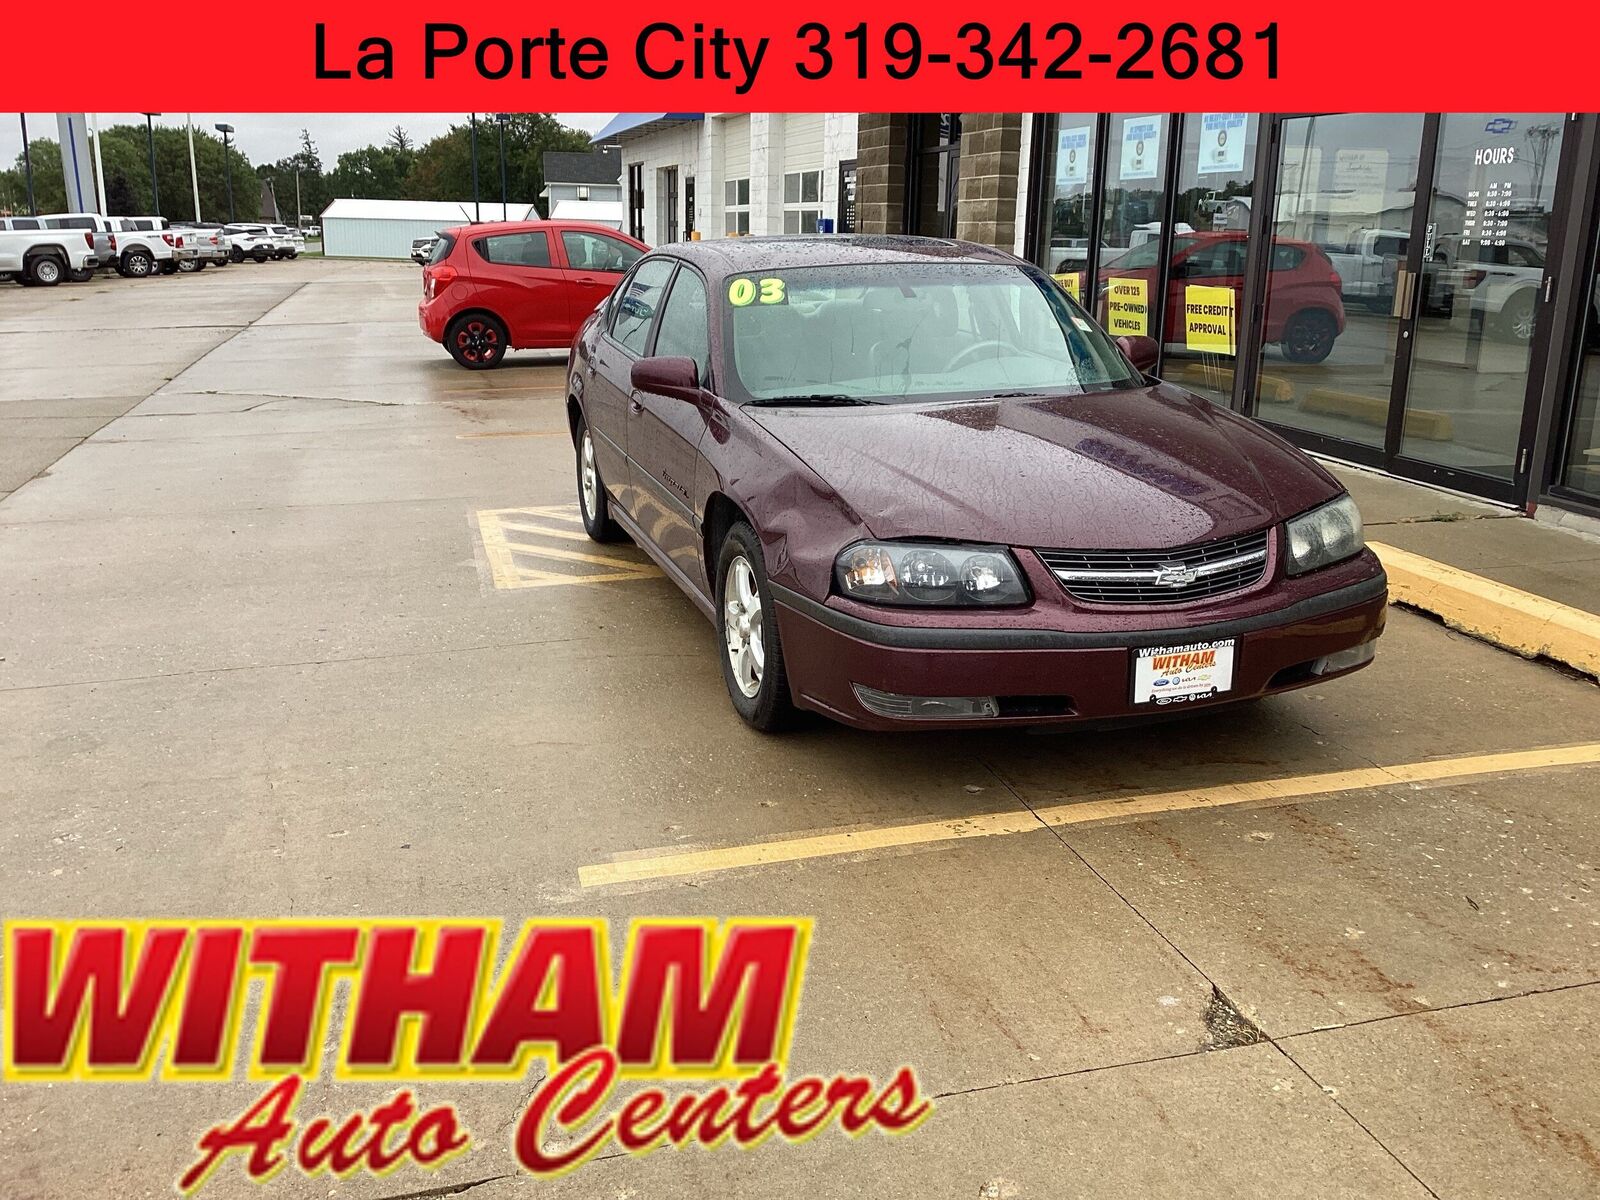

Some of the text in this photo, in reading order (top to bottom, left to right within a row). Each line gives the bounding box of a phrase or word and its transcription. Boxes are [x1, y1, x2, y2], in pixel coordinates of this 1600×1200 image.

[1475, 147, 1515, 165] HOURS
[1425, 224, 1433, 257] PULL
[728, 277, 786, 307] 03
[1114, 285, 1140, 296] OVER 125
[1109, 303, 1145, 314] PRE-OWNED
[1186, 303, 1202, 315] FREE
[1203, 304, 1228, 317] CREDIT
[1113, 318, 1141, 331] VEHICLES
[1189, 321, 1226, 336] APPROVAL
[1139, 639, 1235, 658] Withamauto.com
[1152, 650, 1216, 670] WITHAM
[1160, 661, 1217, 678] Auto Centers
